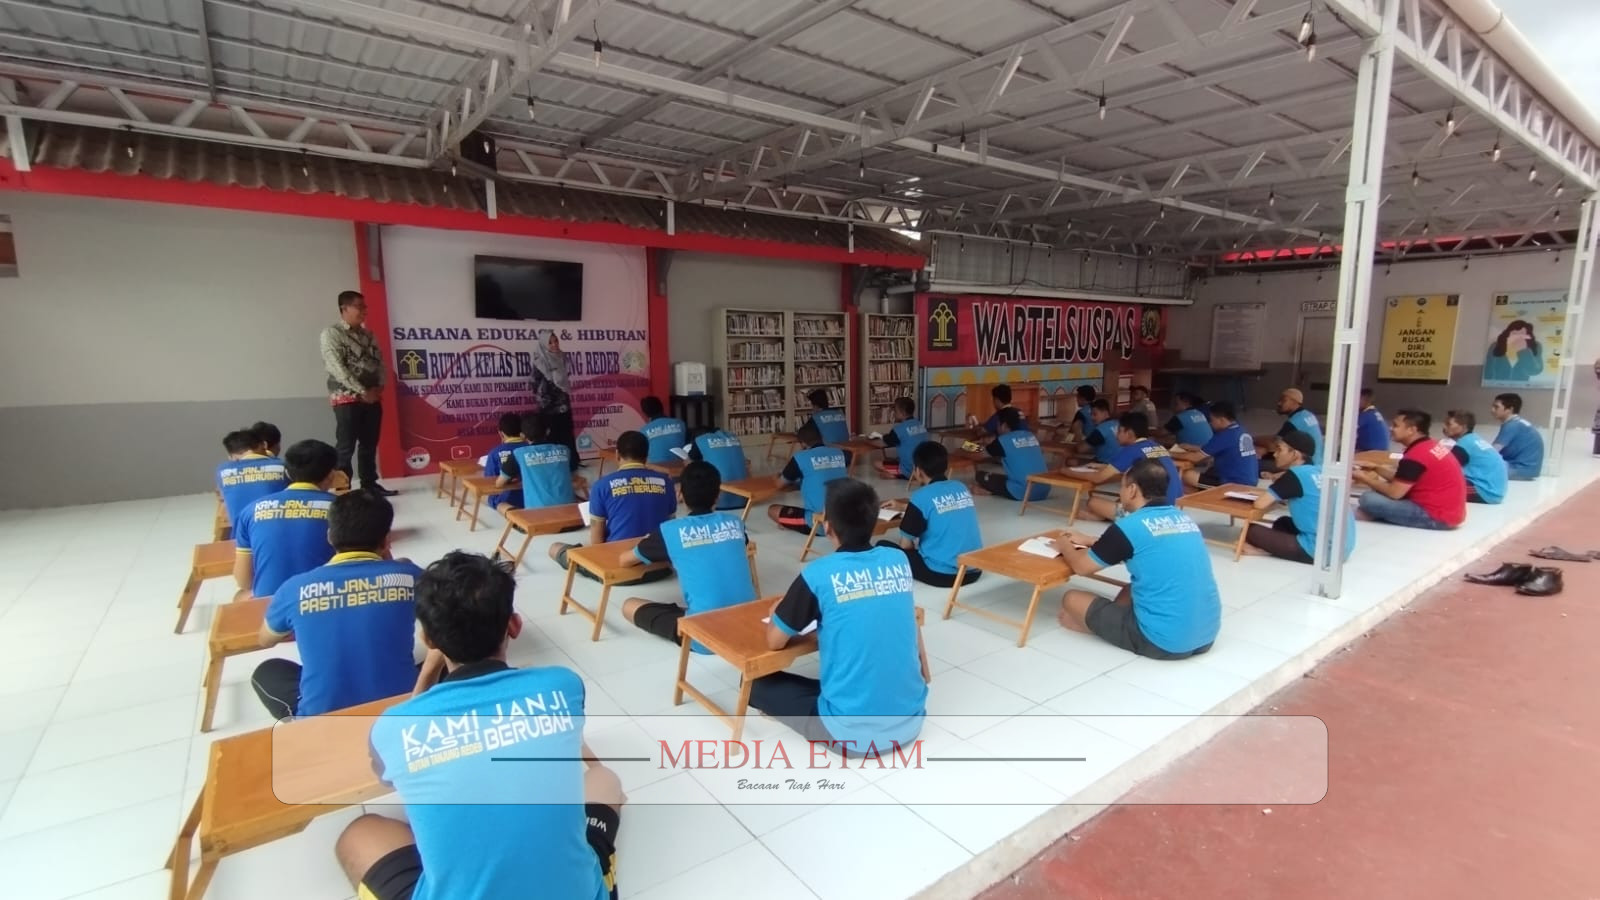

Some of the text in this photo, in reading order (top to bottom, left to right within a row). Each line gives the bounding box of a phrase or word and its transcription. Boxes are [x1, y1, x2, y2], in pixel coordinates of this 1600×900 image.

[393, 327, 472, 341] SARANA
[560, 329, 573, 341] &
[578, 329, 647, 341] HIBURAN
[973, 302, 1135, 365] WARTELSUSPAS
[1398, 328, 1435, 336] JANGAN
[429, 352, 474, 379] RUTAN
[475, 351, 513, 378] KELAS
[586, 351, 620, 376] REDEB
[1392, 359, 1437, 367] NARKOBA
[463, 383, 482, 393] KAMI
[482, 383, 493, 392] INI
[494, 382, 526, 393] PENJAHAT
[447, 398, 465, 409] KAMI
[255, 500, 312, 511] KAMI JANJI
[931, 493, 955, 506] KAMI
[255, 509, 328, 522] PASTI BERUBA
[679, 524, 711, 538] KAMI
[830, 568, 873, 588] KAMI
[300, 576, 383, 600] KAMI JANJI
[834, 581, 874, 596] PASTI
[300, 588, 415, 615] PASTI BERUBAH
[402, 690, 568, 750] KAMI JANJI
[405, 711, 574, 762] PASTI BERUBAH
